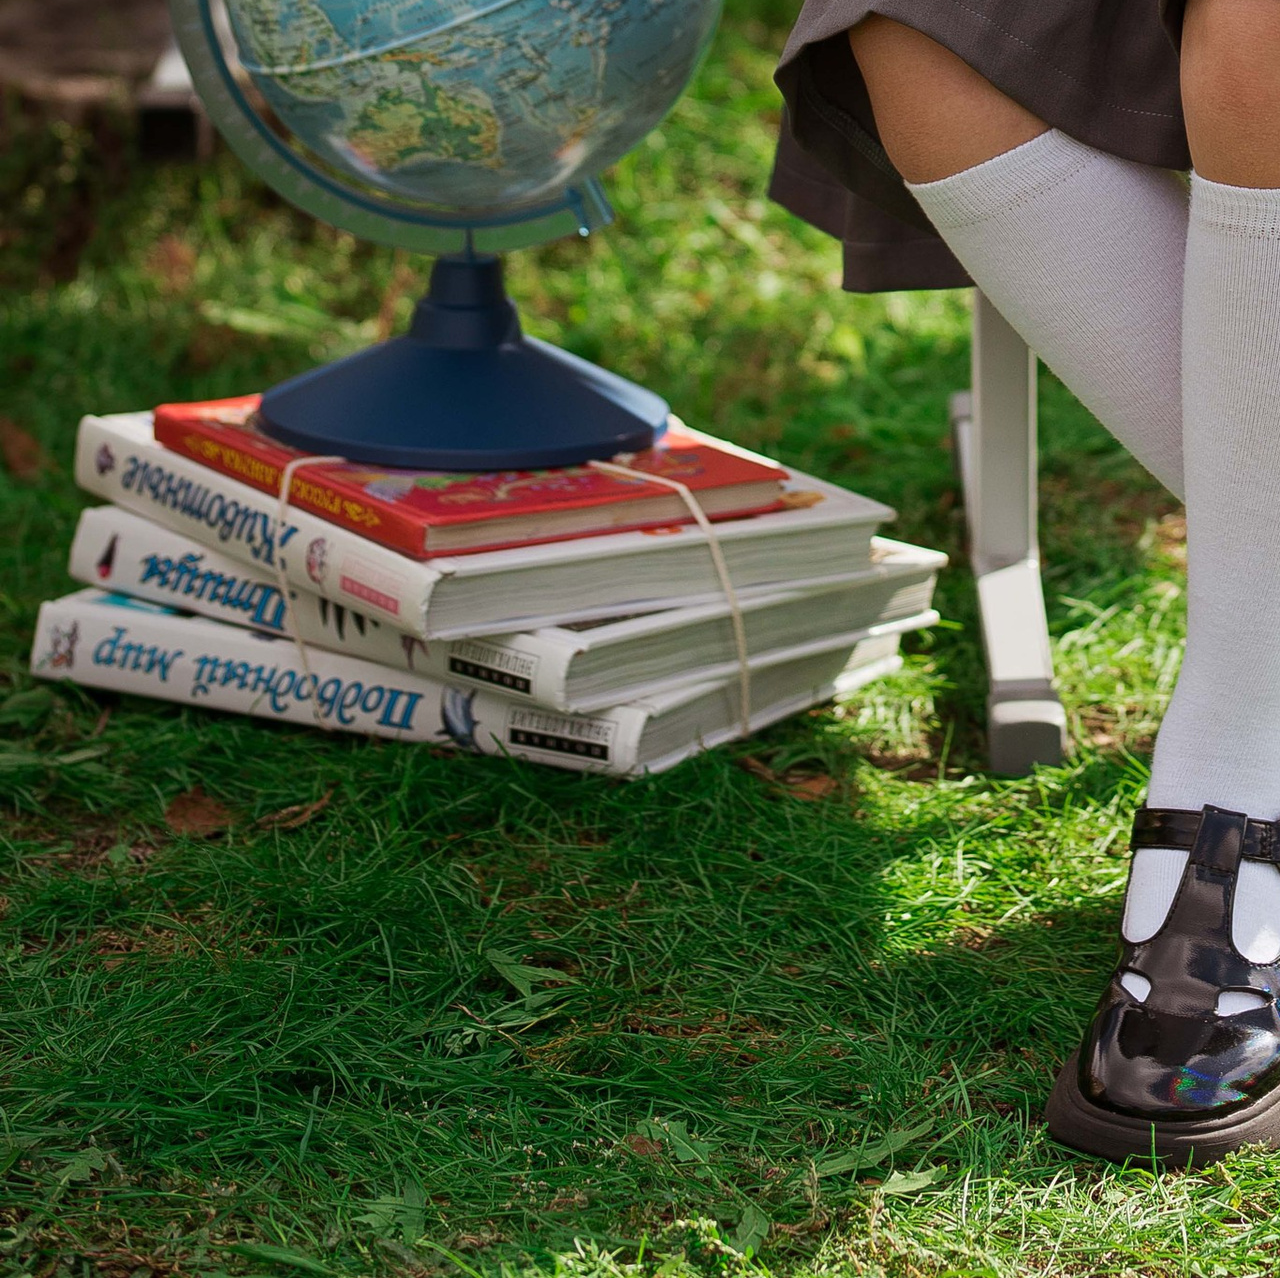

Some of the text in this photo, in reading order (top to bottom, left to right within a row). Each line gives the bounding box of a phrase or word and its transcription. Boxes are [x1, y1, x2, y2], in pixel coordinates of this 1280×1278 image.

[138, 554, 298, 631] Птицы
[91, 627, 425, 731] Подводный мир
